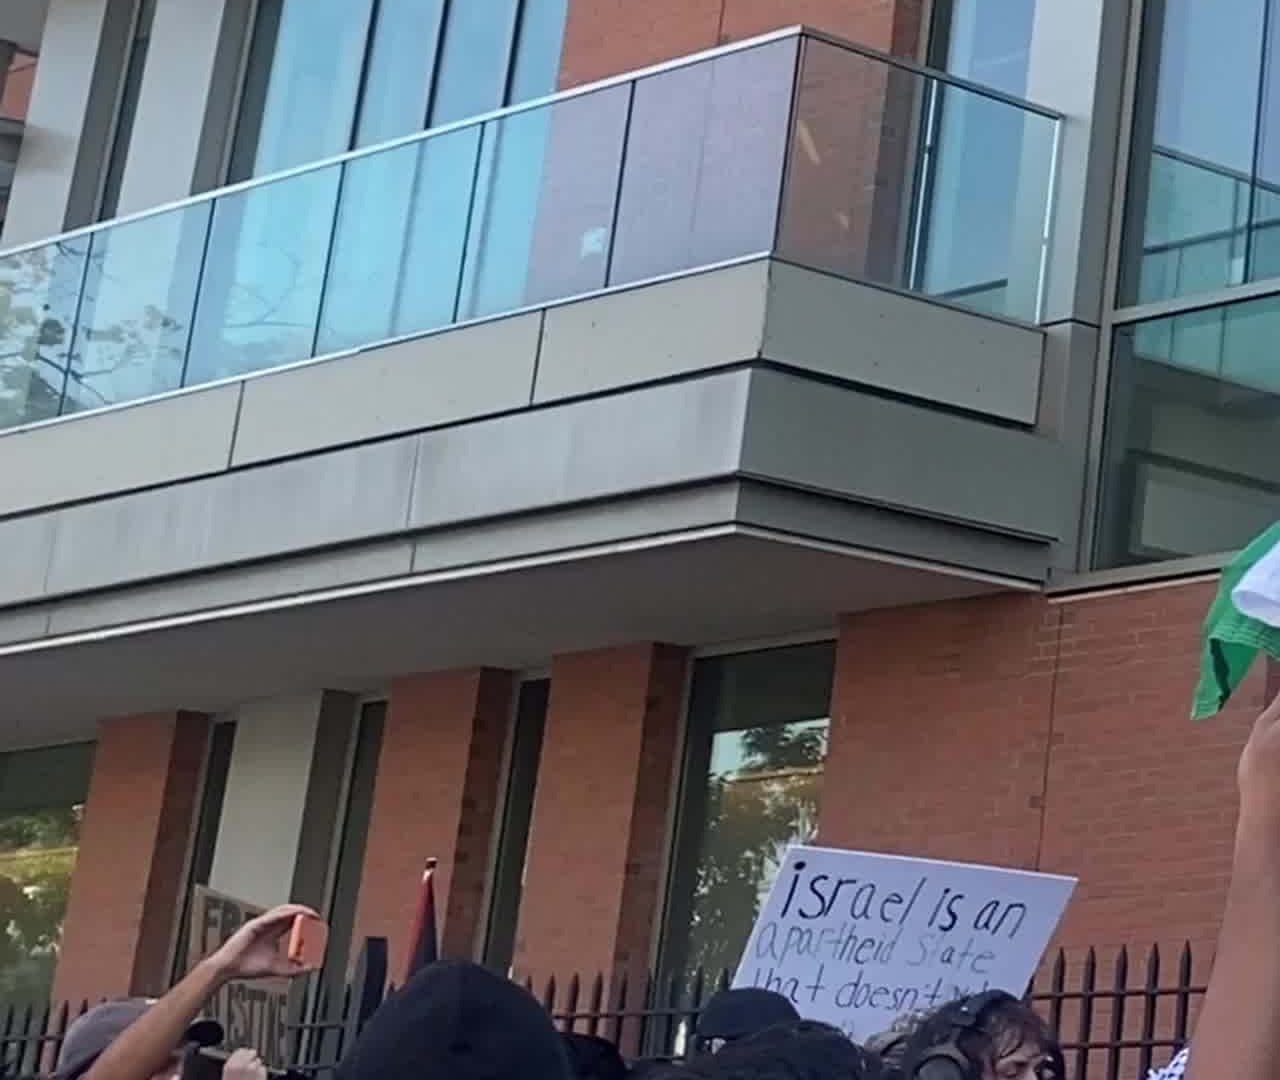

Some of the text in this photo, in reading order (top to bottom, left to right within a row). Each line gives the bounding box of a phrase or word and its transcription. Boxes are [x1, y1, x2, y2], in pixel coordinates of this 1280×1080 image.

[781, 861, 1026, 940] israel is an
[756, 919, 904, 969] apartheid
